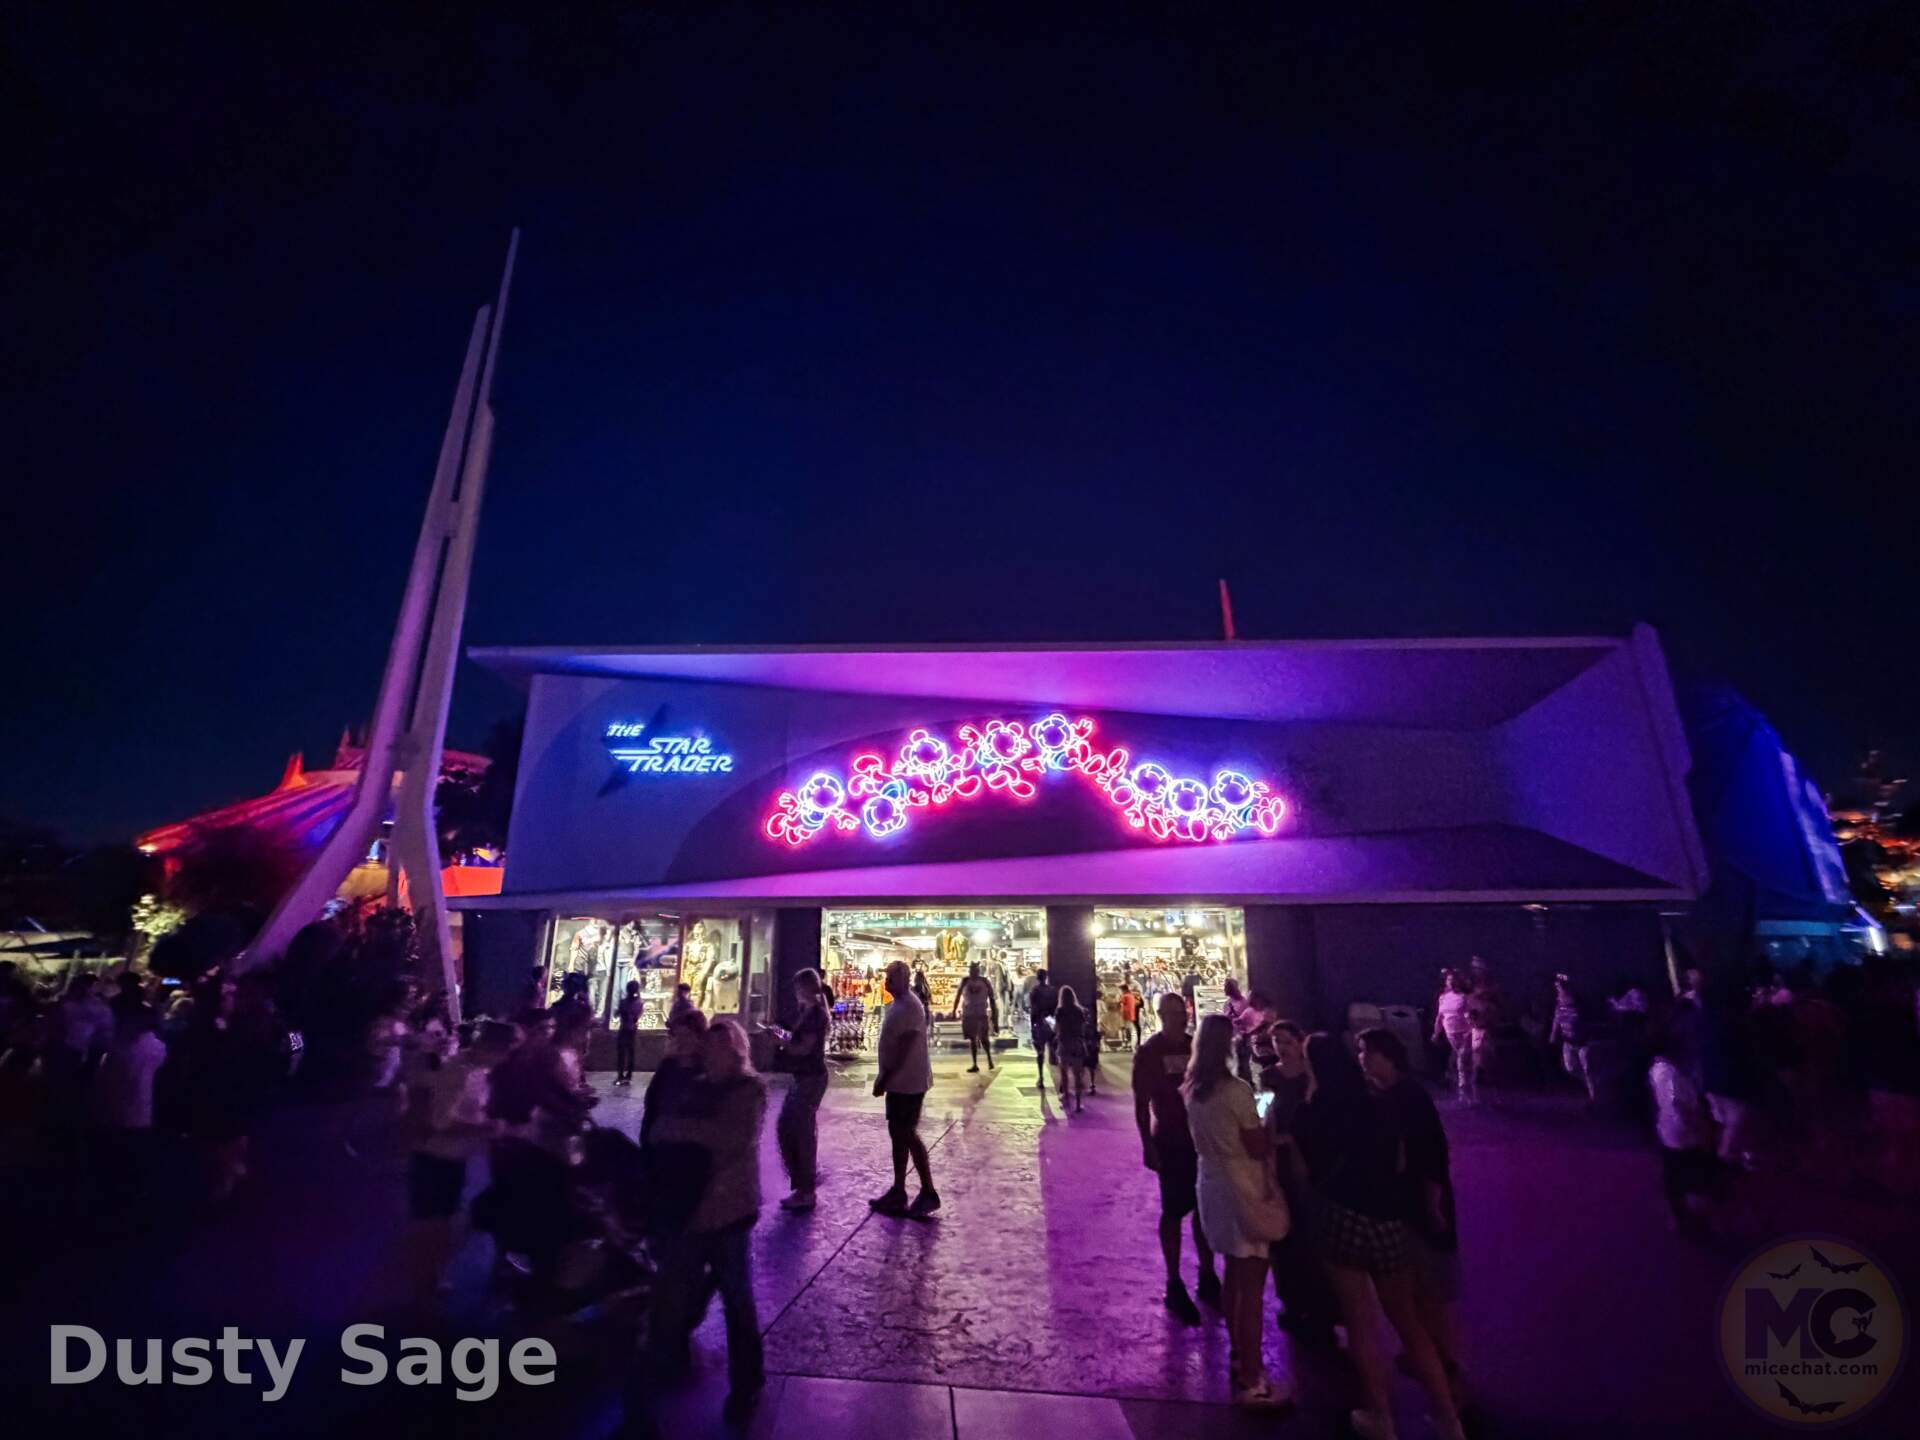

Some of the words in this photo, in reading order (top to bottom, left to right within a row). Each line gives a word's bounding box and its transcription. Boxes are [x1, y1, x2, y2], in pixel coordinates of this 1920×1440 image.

[606, 723, 645, 737] THE
[638, 737, 712, 755] STAR
[616, 754, 734, 773] TRADER
